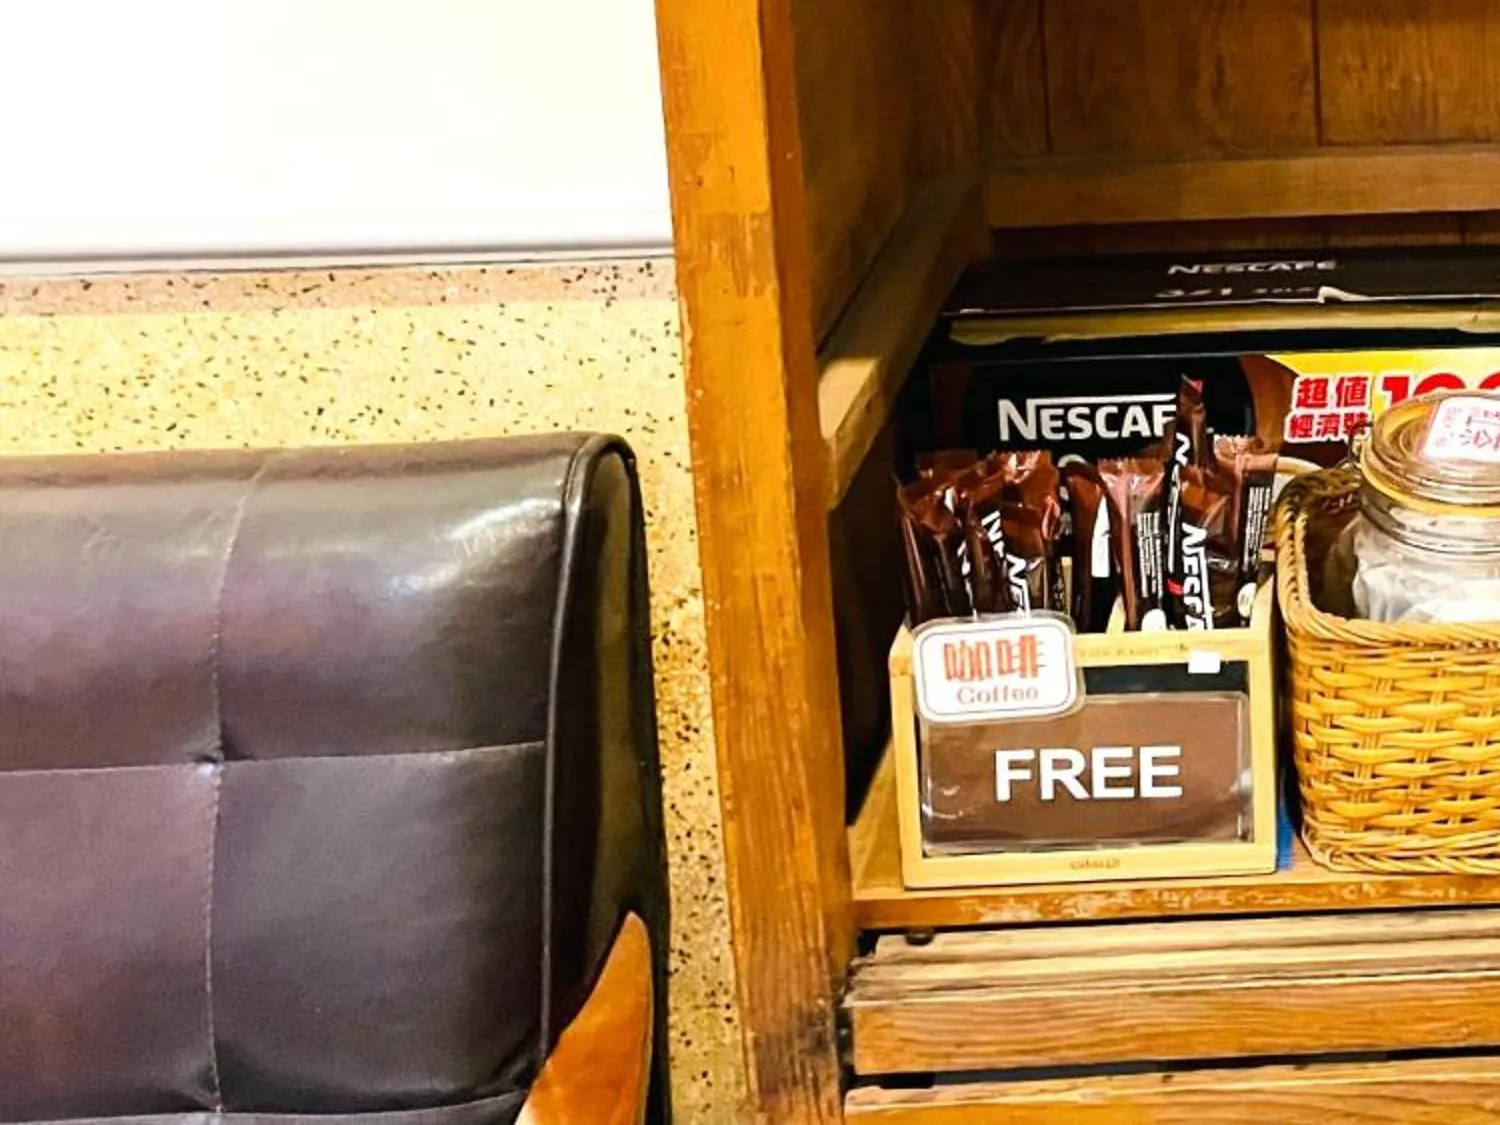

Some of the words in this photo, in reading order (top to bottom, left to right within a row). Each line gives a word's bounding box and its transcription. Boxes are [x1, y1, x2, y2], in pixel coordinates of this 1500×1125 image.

[998, 393, 1177, 442] NESCAF
[957, 684, 1039, 705] Coffee
[993, 746, 1183, 801] FREE
